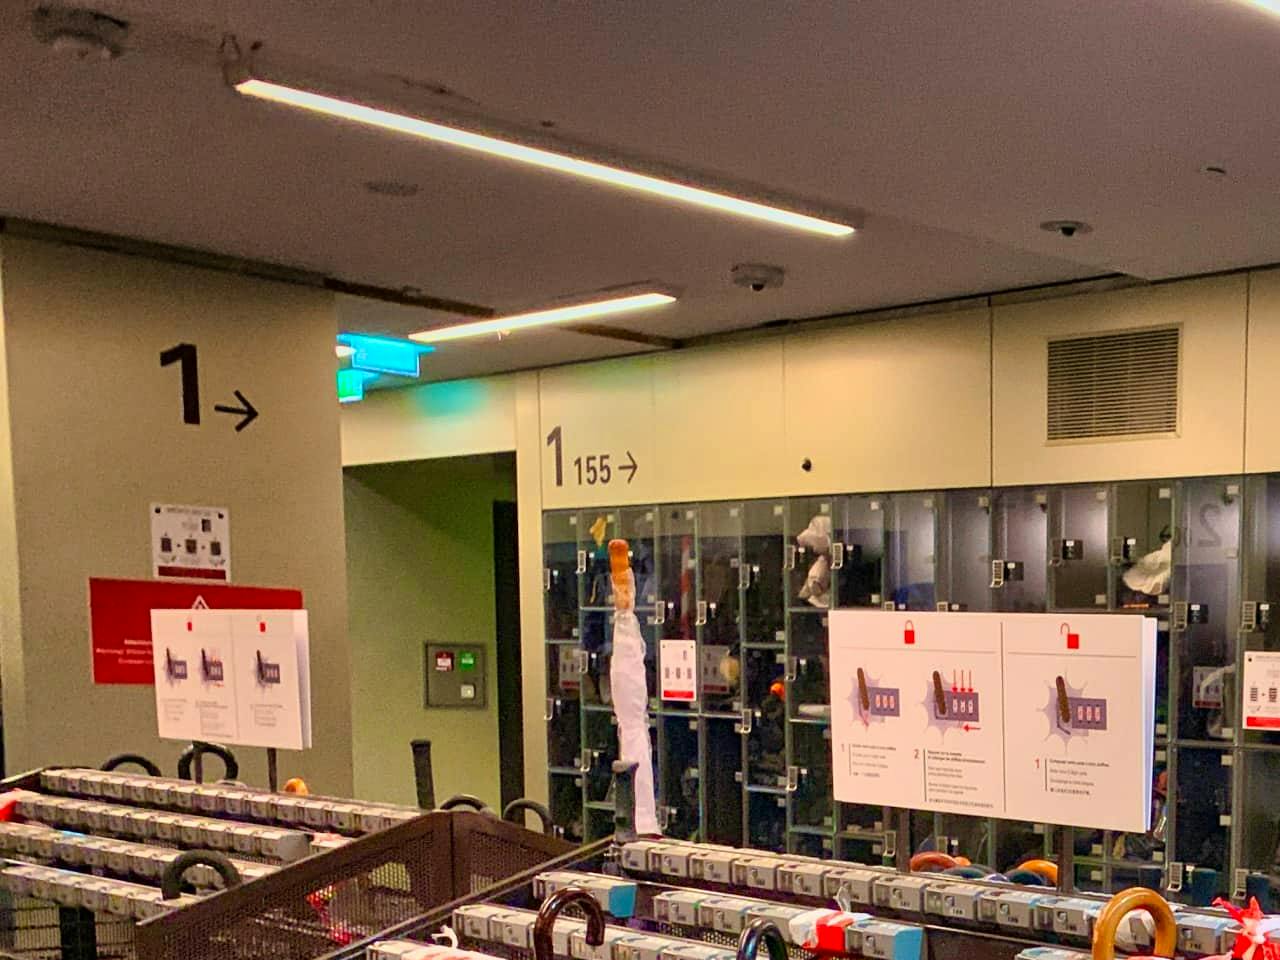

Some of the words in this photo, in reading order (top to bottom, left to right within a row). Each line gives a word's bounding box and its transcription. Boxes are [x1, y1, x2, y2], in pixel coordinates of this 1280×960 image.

[160, 343, 200, 425] 1
[547, 426, 563, 487] 1
[574, 454, 611, 485] 155
[914, 749, 920, 760] 2
[1035, 758, 1040, 769] 1
